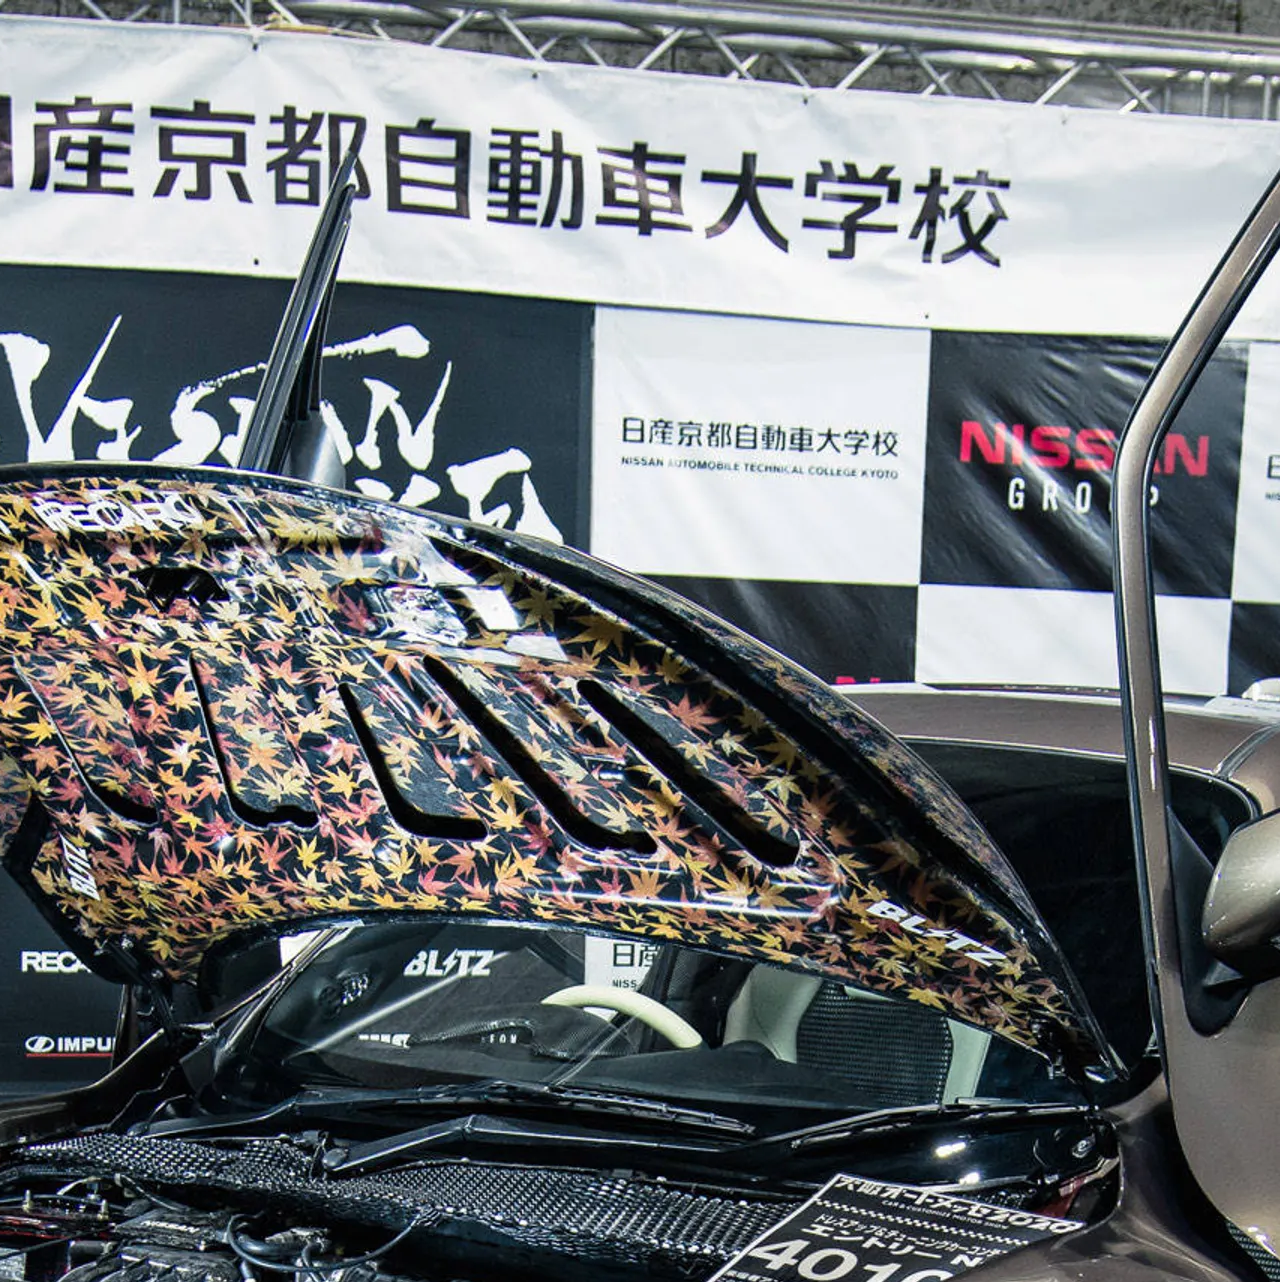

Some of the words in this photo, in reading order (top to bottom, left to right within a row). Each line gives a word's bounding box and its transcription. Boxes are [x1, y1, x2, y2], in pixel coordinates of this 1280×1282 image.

[622, 416, 899, 458] 日産京都自動車大学校
[959, 420, 1210, 477] NISSN
[621, 456, 664, 467] NISSAN
[668, 459, 740, 472] AUTOMOBILE
[744, 463, 804, 475] TECHNICAL
[808, 465, 857, 477] COLLEGE
[860, 468, 898, 480] KYOTO
[1007, 476, 1159, 515] GRO
[59, 831, 101, 901] BLITZ
[866, 899, 1007, 967] BLITZ
[403, 948, 495, 977] BLITZ
[57, 1036, 117, 1052] IMPU
[800, 1224, 943, 1260] エントリー
[954, 1252, 986, 1269] N
